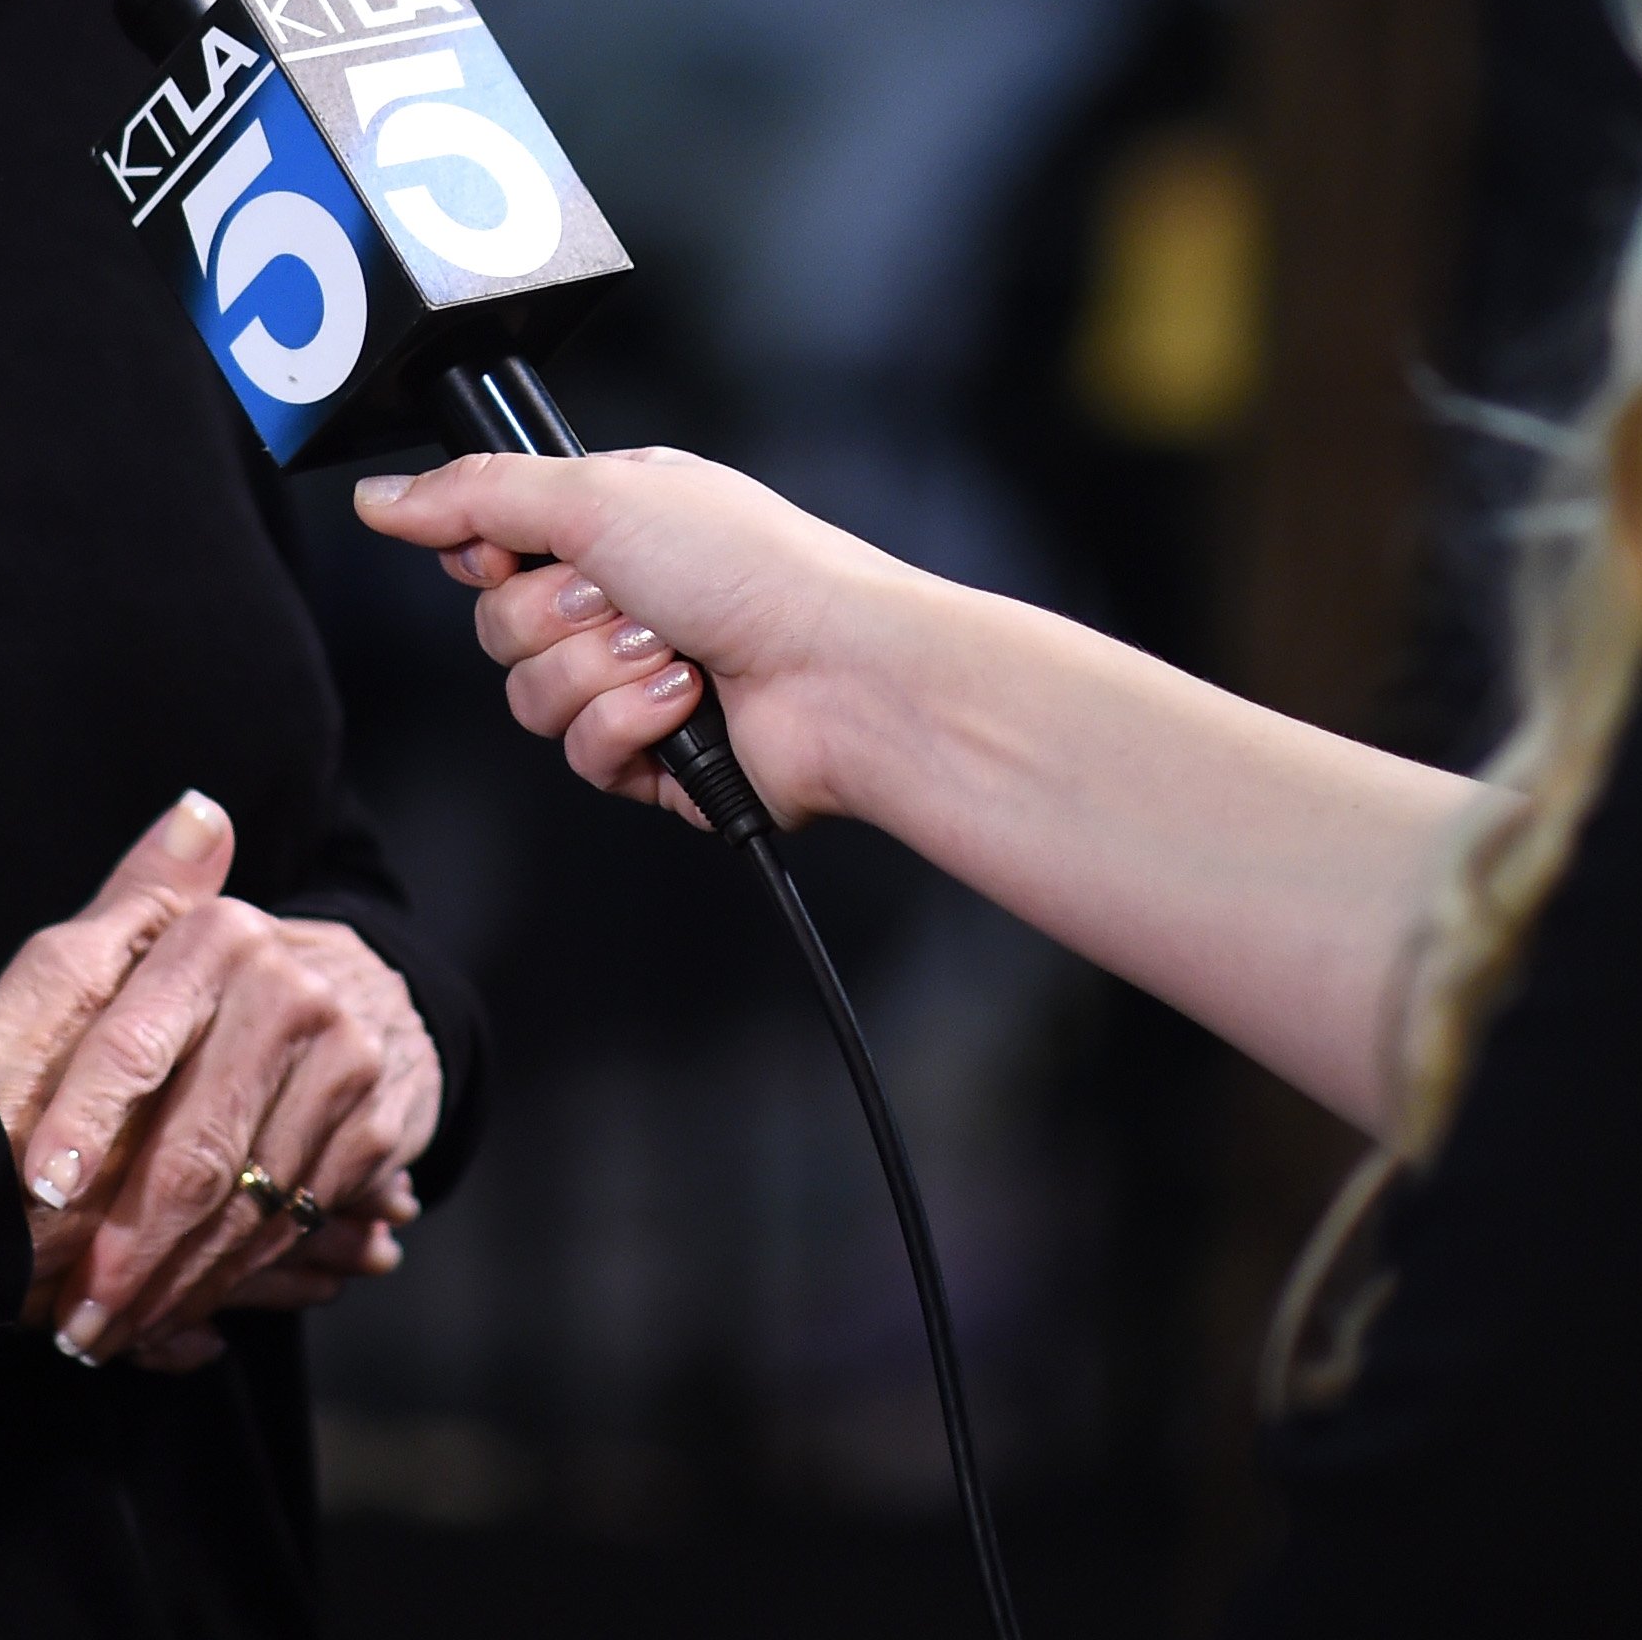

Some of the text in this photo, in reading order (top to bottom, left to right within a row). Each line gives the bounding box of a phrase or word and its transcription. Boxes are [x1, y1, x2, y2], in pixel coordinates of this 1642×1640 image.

[102, 26, 260, 203] KTLA
[345, 49, 563, 278] 5
[183, 118, 367, 405] 5
